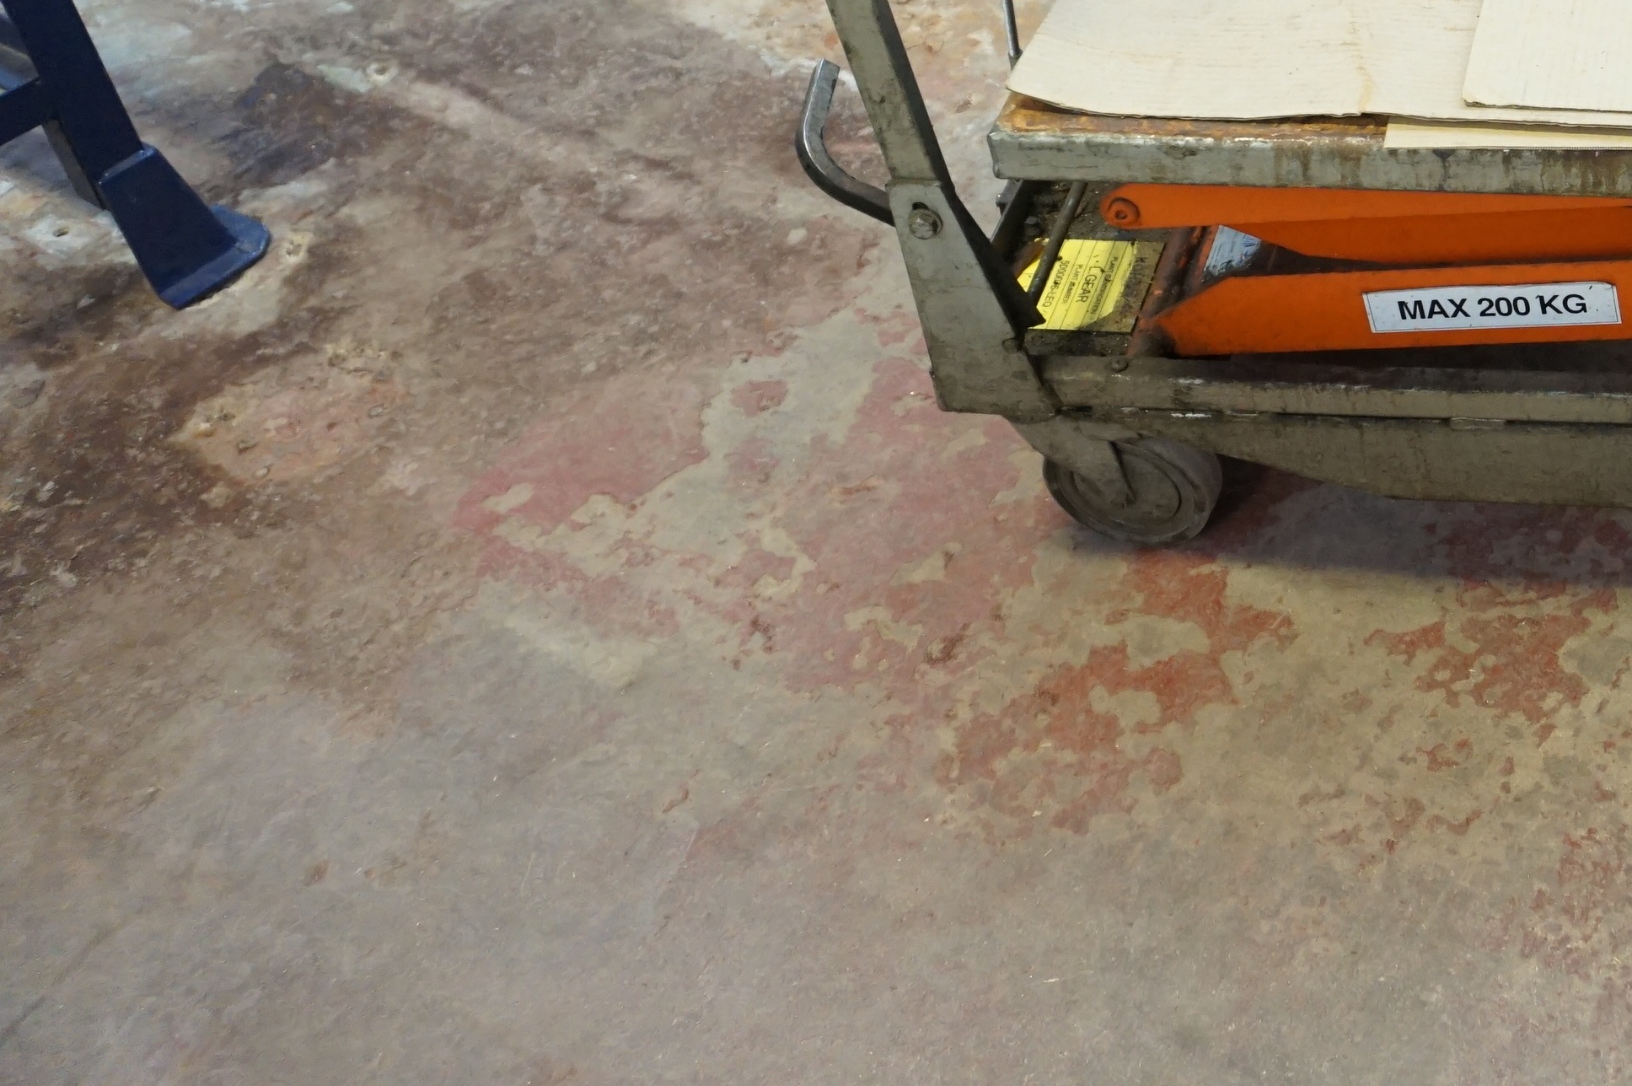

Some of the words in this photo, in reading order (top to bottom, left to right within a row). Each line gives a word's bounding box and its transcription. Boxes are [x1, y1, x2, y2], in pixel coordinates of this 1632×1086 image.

[1397, 297, 1469, 320] MAX
[1477, 296, 1531, 317] 200
[1539, 293, 1588, 315] KG
